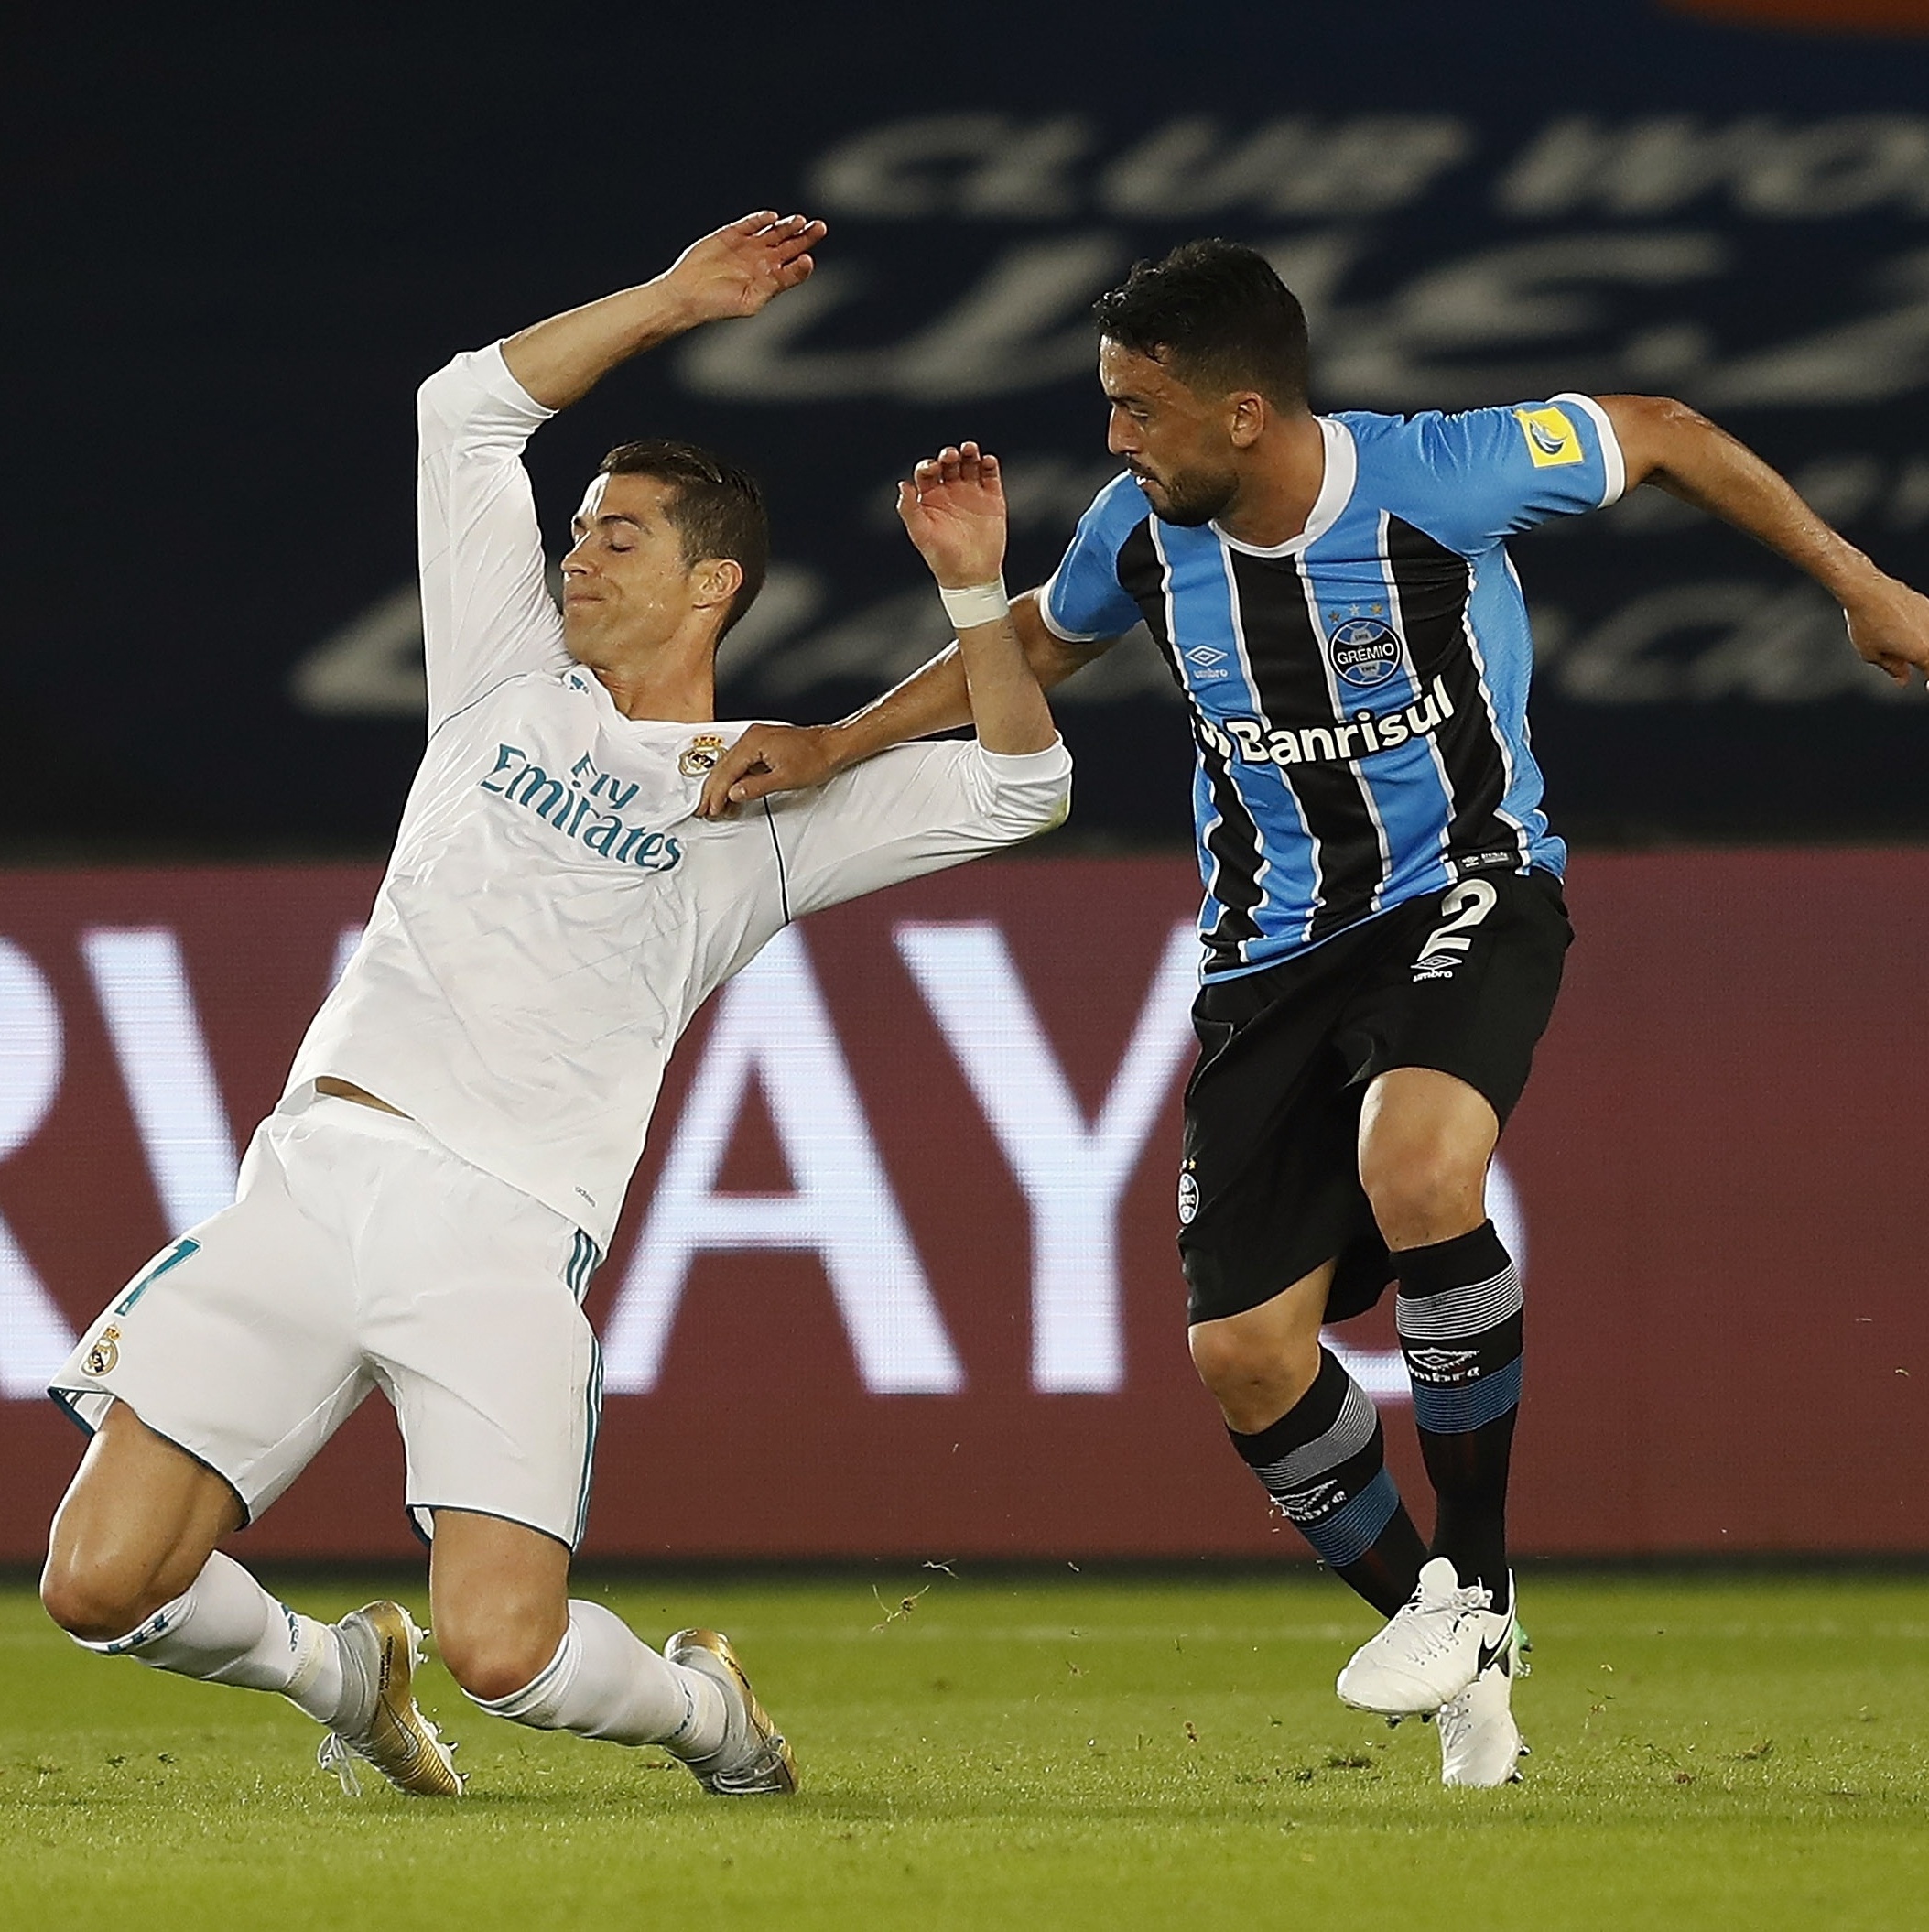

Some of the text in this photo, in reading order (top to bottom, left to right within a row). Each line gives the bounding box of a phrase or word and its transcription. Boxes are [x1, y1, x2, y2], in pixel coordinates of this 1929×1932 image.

[1226, 674, 1456, 765] Banrisul
[480, 743, 682, 871] Emirates
[570, 750, 641, 810] Fly
[1416, 878, 1498, 961] 2
[1413, 970, 1454, 982] umbro
